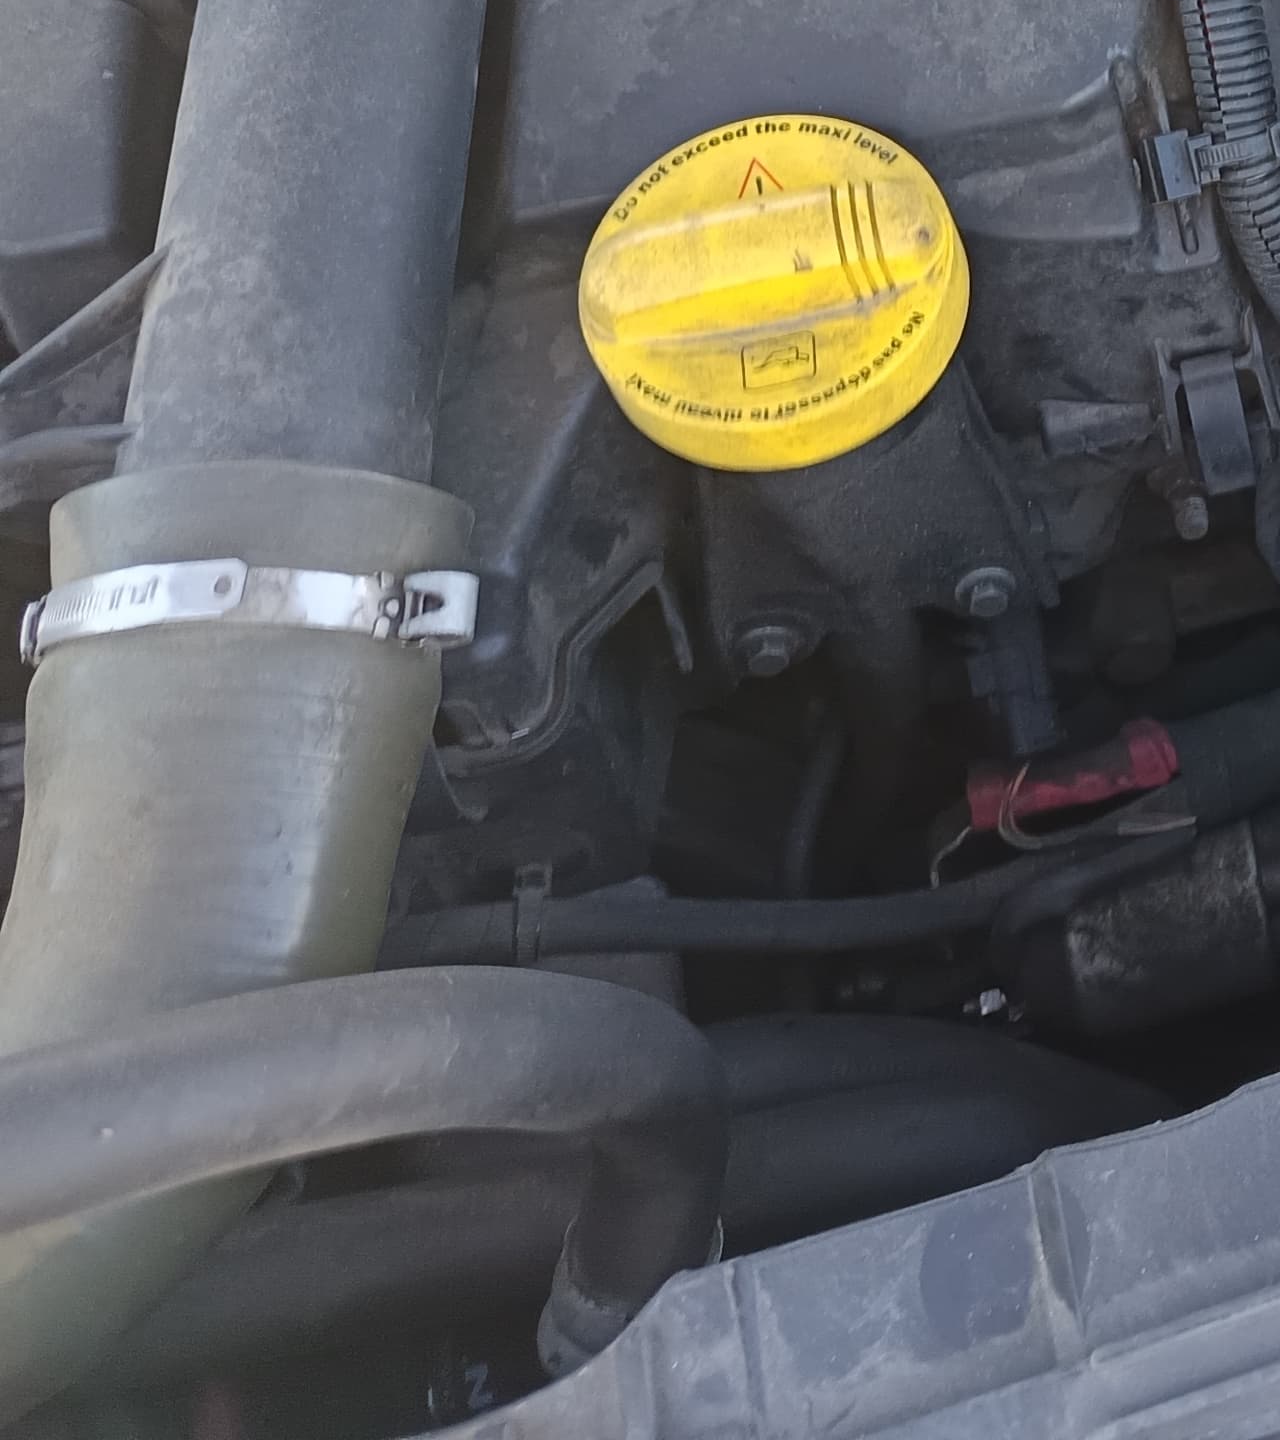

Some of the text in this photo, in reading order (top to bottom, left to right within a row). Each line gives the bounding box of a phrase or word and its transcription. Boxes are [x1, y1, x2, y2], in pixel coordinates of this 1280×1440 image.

[638, 163, 669, 194] not
[671, 124, 749, 167] exceed
[755, 120, 791, 134] the
[798, 121, 851, 140] maxi
[853, 132, 899, 165] level
